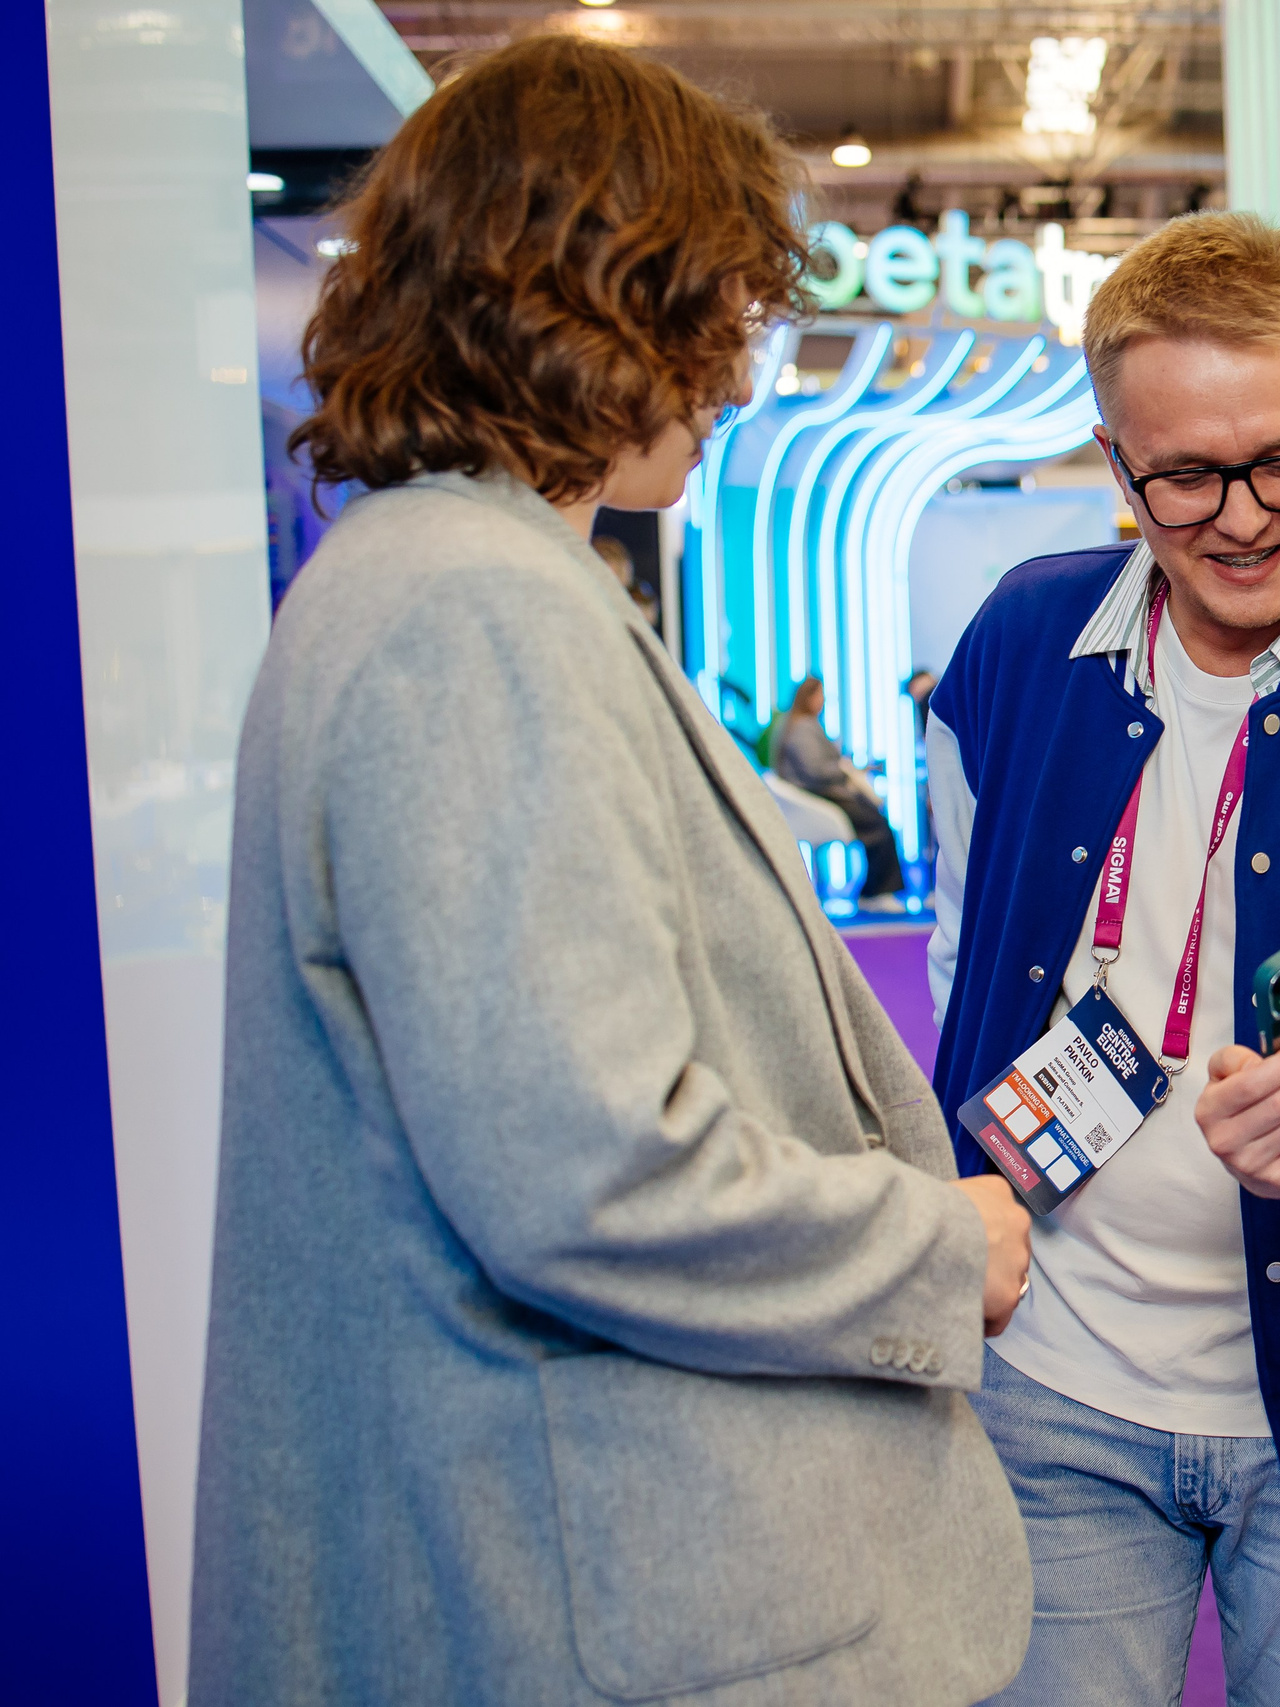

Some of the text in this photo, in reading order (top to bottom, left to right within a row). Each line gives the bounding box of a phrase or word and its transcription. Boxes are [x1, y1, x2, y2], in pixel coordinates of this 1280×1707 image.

[1177, 918, 1200, 1014] BETCONSTRUCT
[1063, 1044, 1095, 1083] PIATKIN
[1072, 1035, 1100, 1069] PAVLO
[1095, 1032, 1133, 1080] EUROPE
[1100, 1021, 1140, 1074] CENTRAL
[1017, 1079, 1040, 1106] LOOKING
[1037, 1072, 1054, 1092] EVENTS
[1053, 1122, 1070, 1140] WHAT
[989, 1134, 1022, 1172] BETCONSTRUCT
